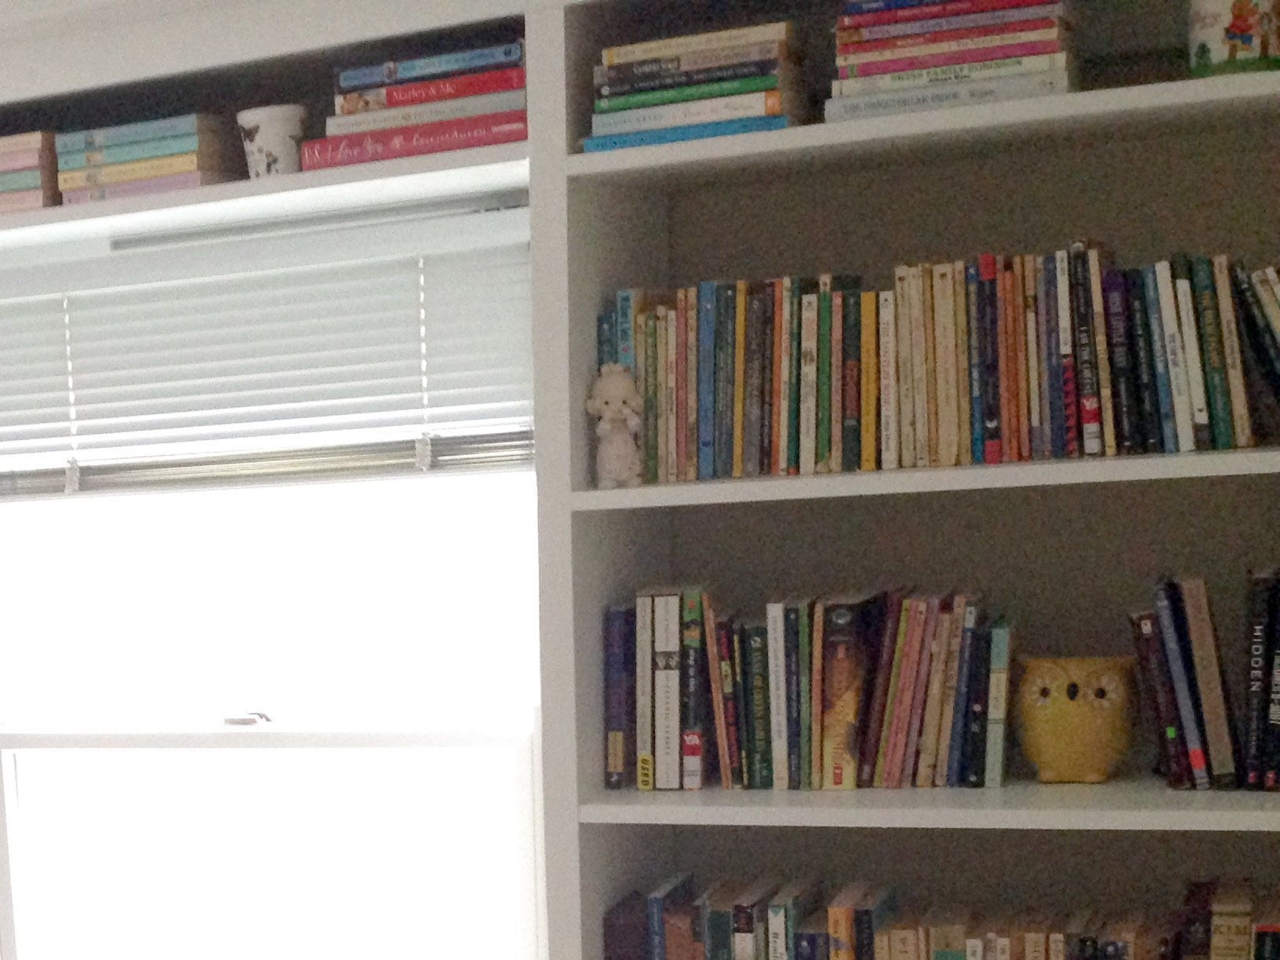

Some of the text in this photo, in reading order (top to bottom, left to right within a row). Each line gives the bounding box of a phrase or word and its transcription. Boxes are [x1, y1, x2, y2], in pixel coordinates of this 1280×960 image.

[390, 80, 456, 102] Marley & Me
[335, 139, 358, 159] Love
[361, 134, 385, 160] You
[1249, 624, 1263, 692] HIDDEN
[640, 757, 649, 786] USED
